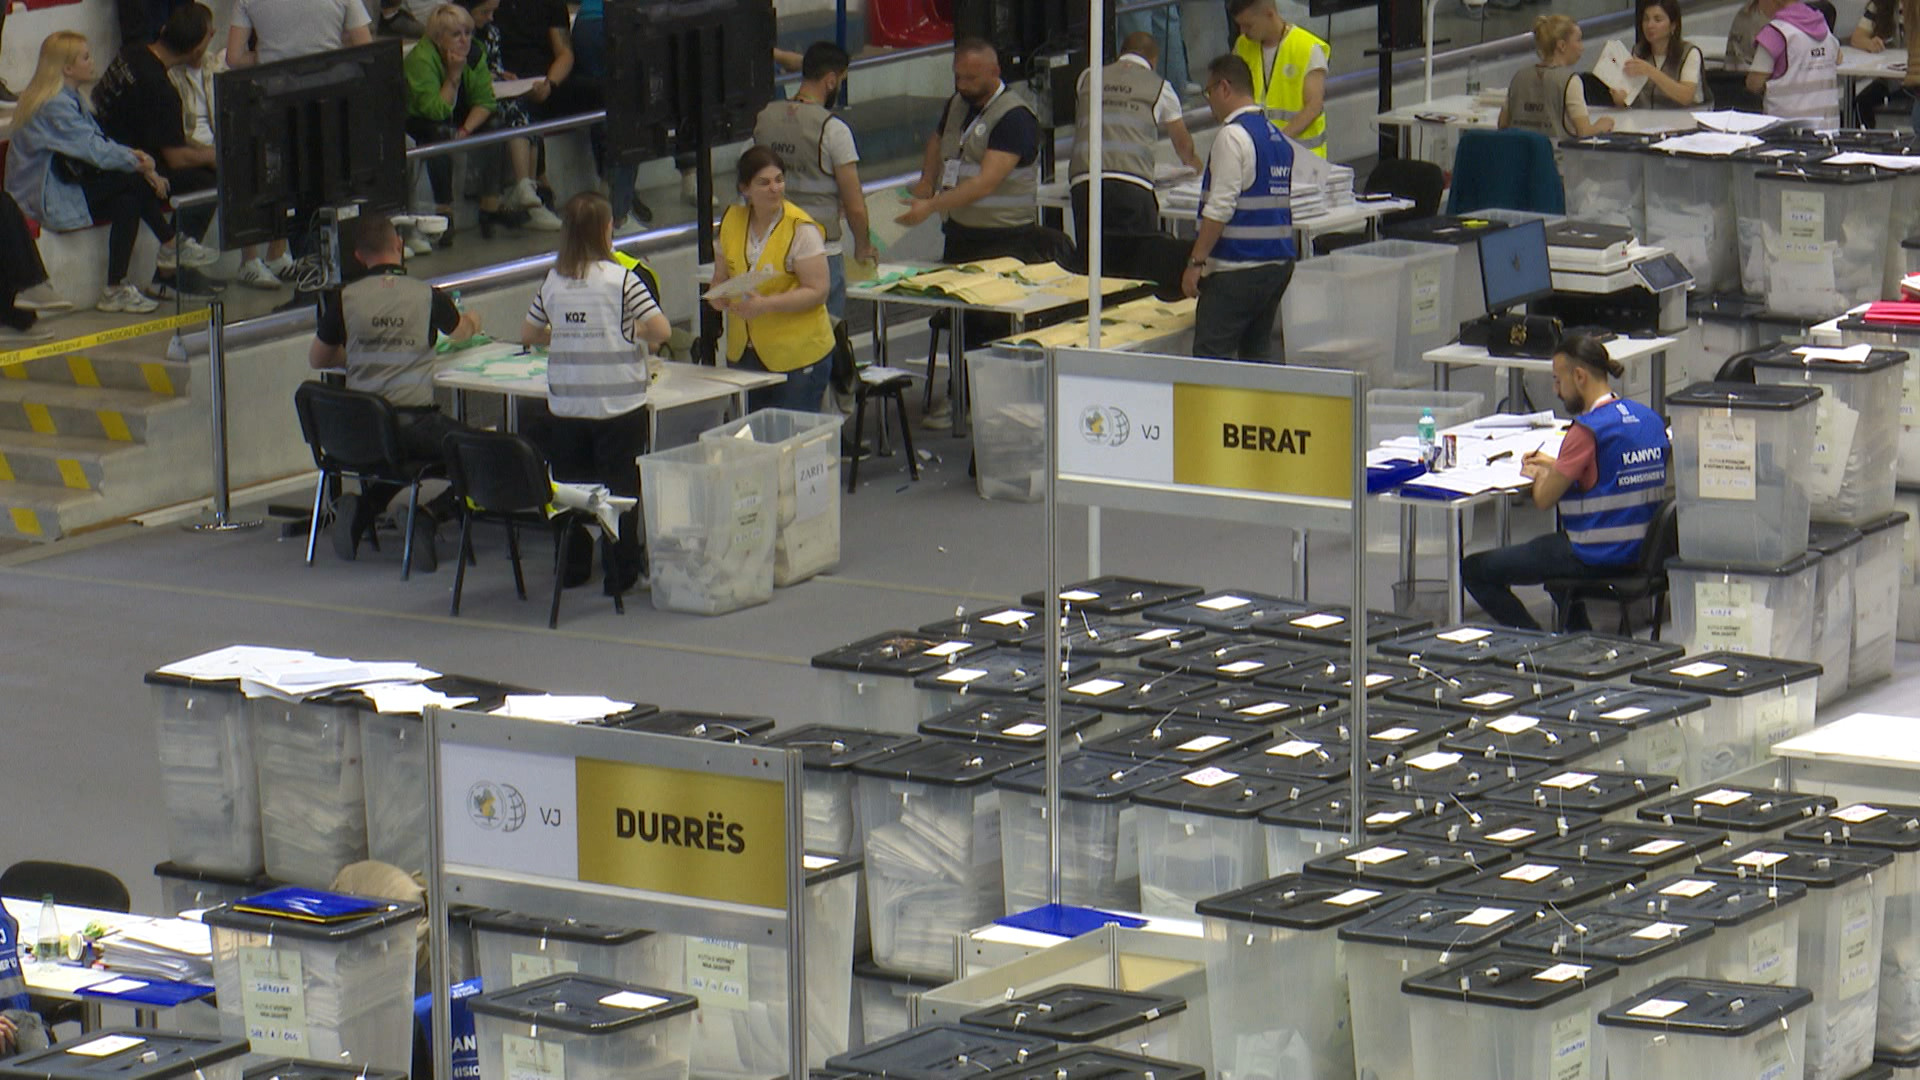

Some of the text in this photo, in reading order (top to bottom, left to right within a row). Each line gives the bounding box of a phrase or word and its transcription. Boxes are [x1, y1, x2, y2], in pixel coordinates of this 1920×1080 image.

[372, 316, 404, 328] GNVJ
[565, 311, 586, 323] KQZ
[1141, 424, 1160, 441] VJ
[1223, 423, 1311, 455] BERAT
[540, 807, 561, 827] VJ
[616, 807, 745, 854] DURRËS
